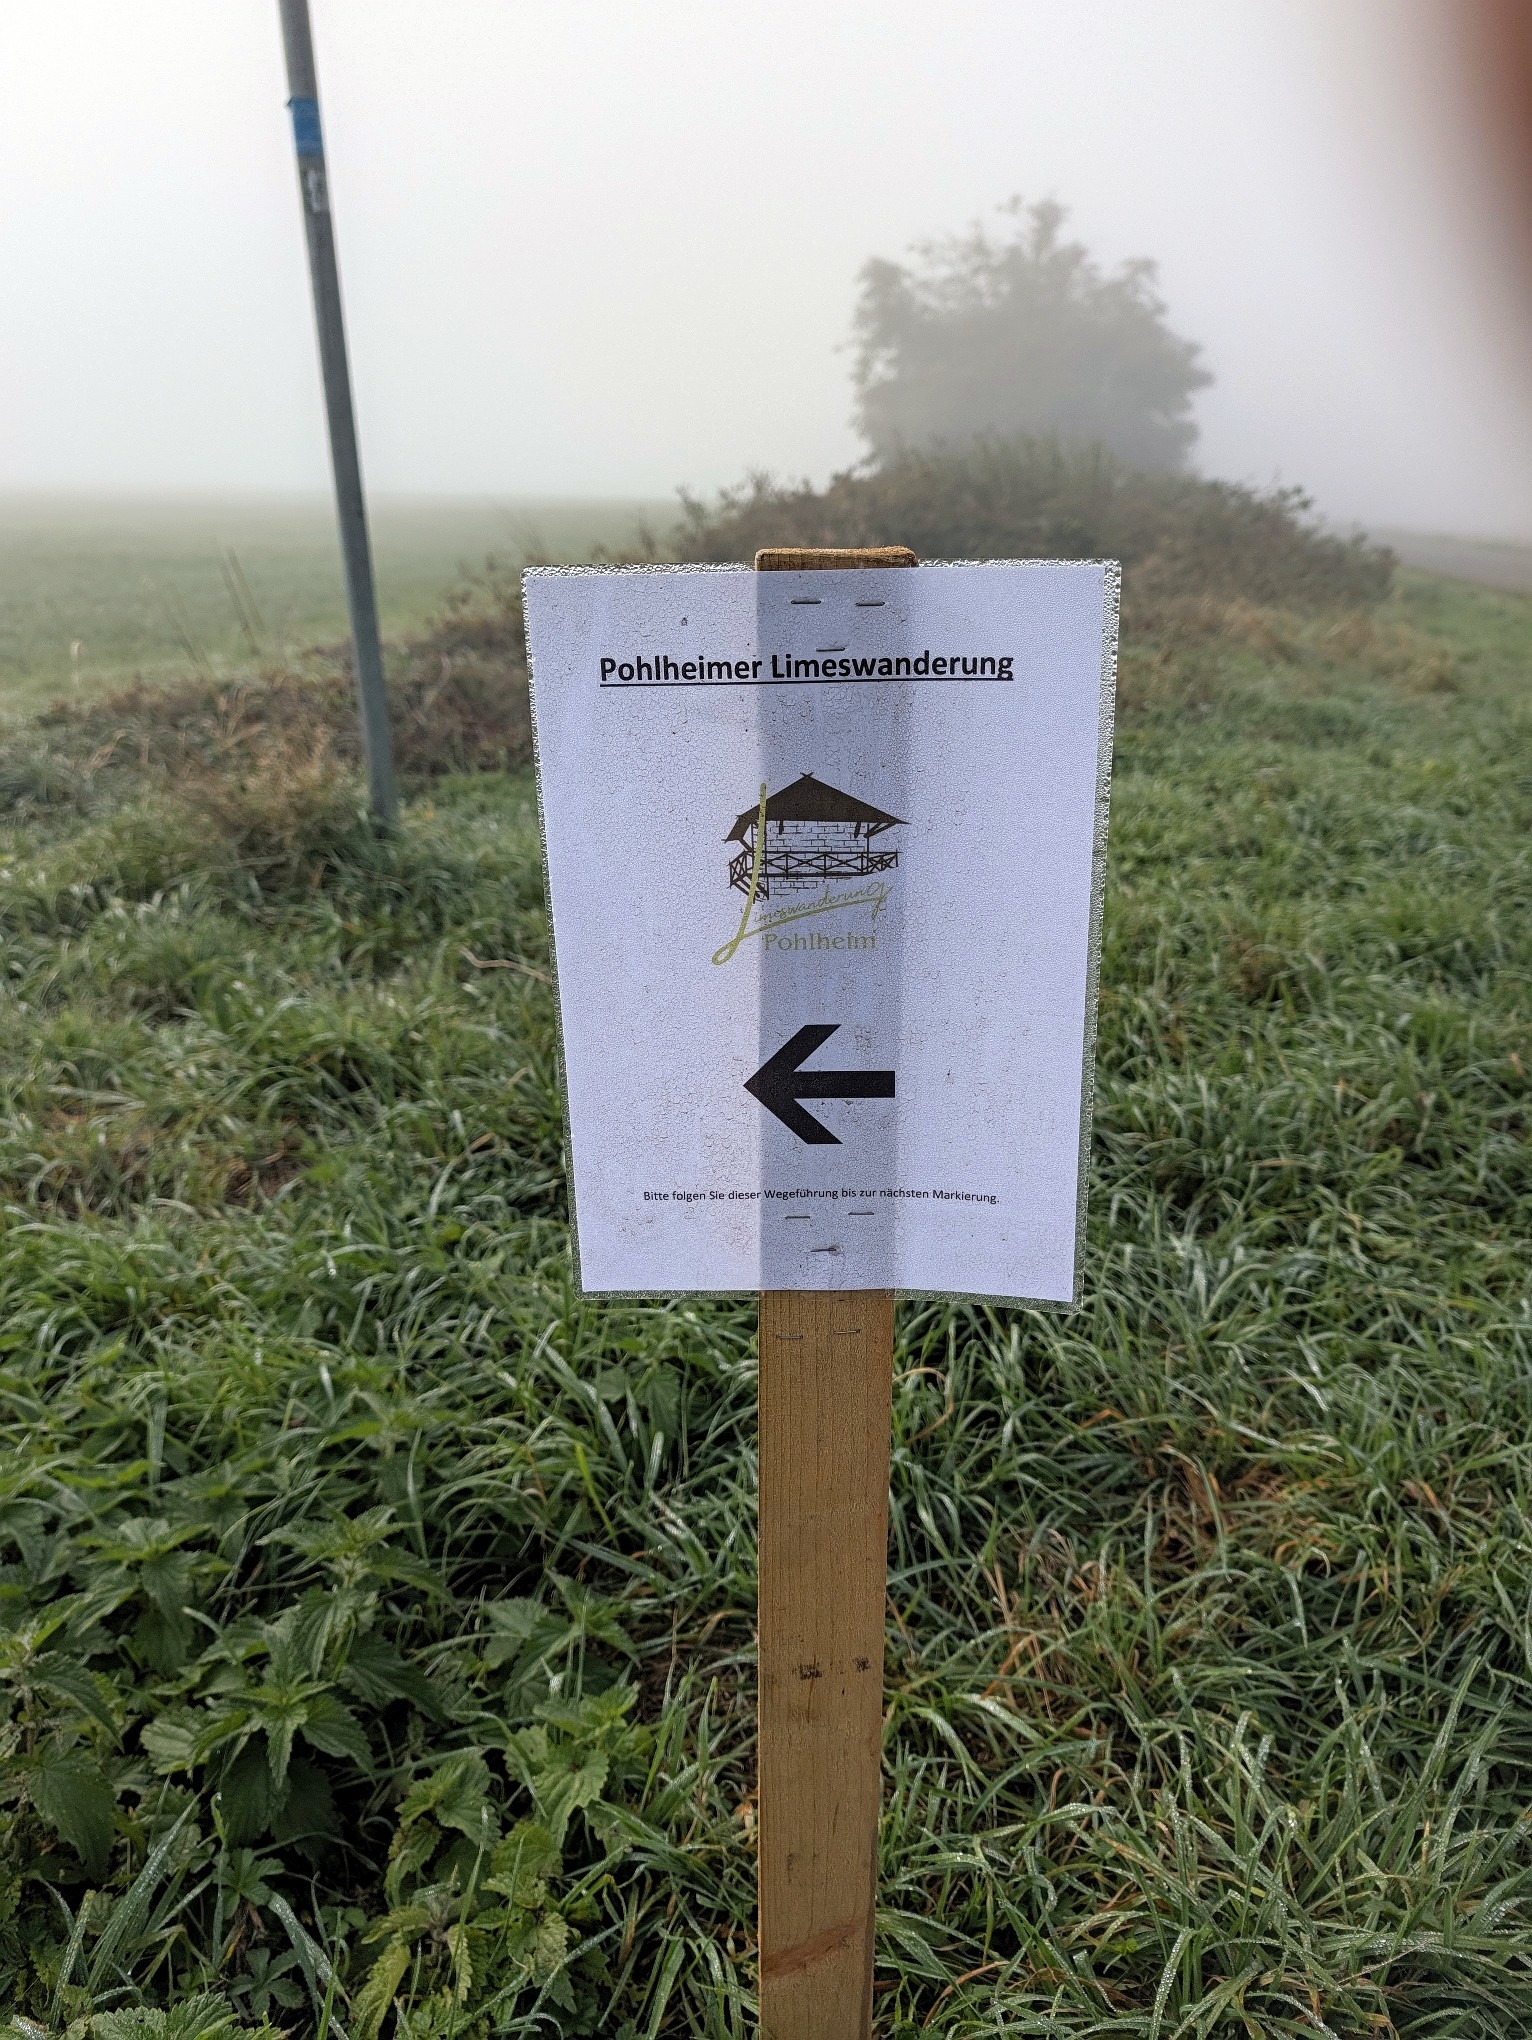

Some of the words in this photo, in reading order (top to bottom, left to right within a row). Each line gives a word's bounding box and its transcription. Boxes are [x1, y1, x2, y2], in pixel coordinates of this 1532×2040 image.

[600, 656, 762, 681] Pohlheimer
[771, 651, 1014, 680] Limeswanderung
[764, 932, 877, 951] Pohlheim
[644, 1191, 669, 1200] Bitte
[672, 1190, 706, 1202] folgen
[709, 1190, 725, 1200] Sie
[728, 1190, 761, 1200] dieser
[764, 1188, 839, 1200] Wegeführung
[842, 1188, 857, 1198] bis
[859, 1190, 877, 1198] zur
[880, 1188, 929, 1199] nächsten
[933, 1190, 1000, 1204] Markierung.
